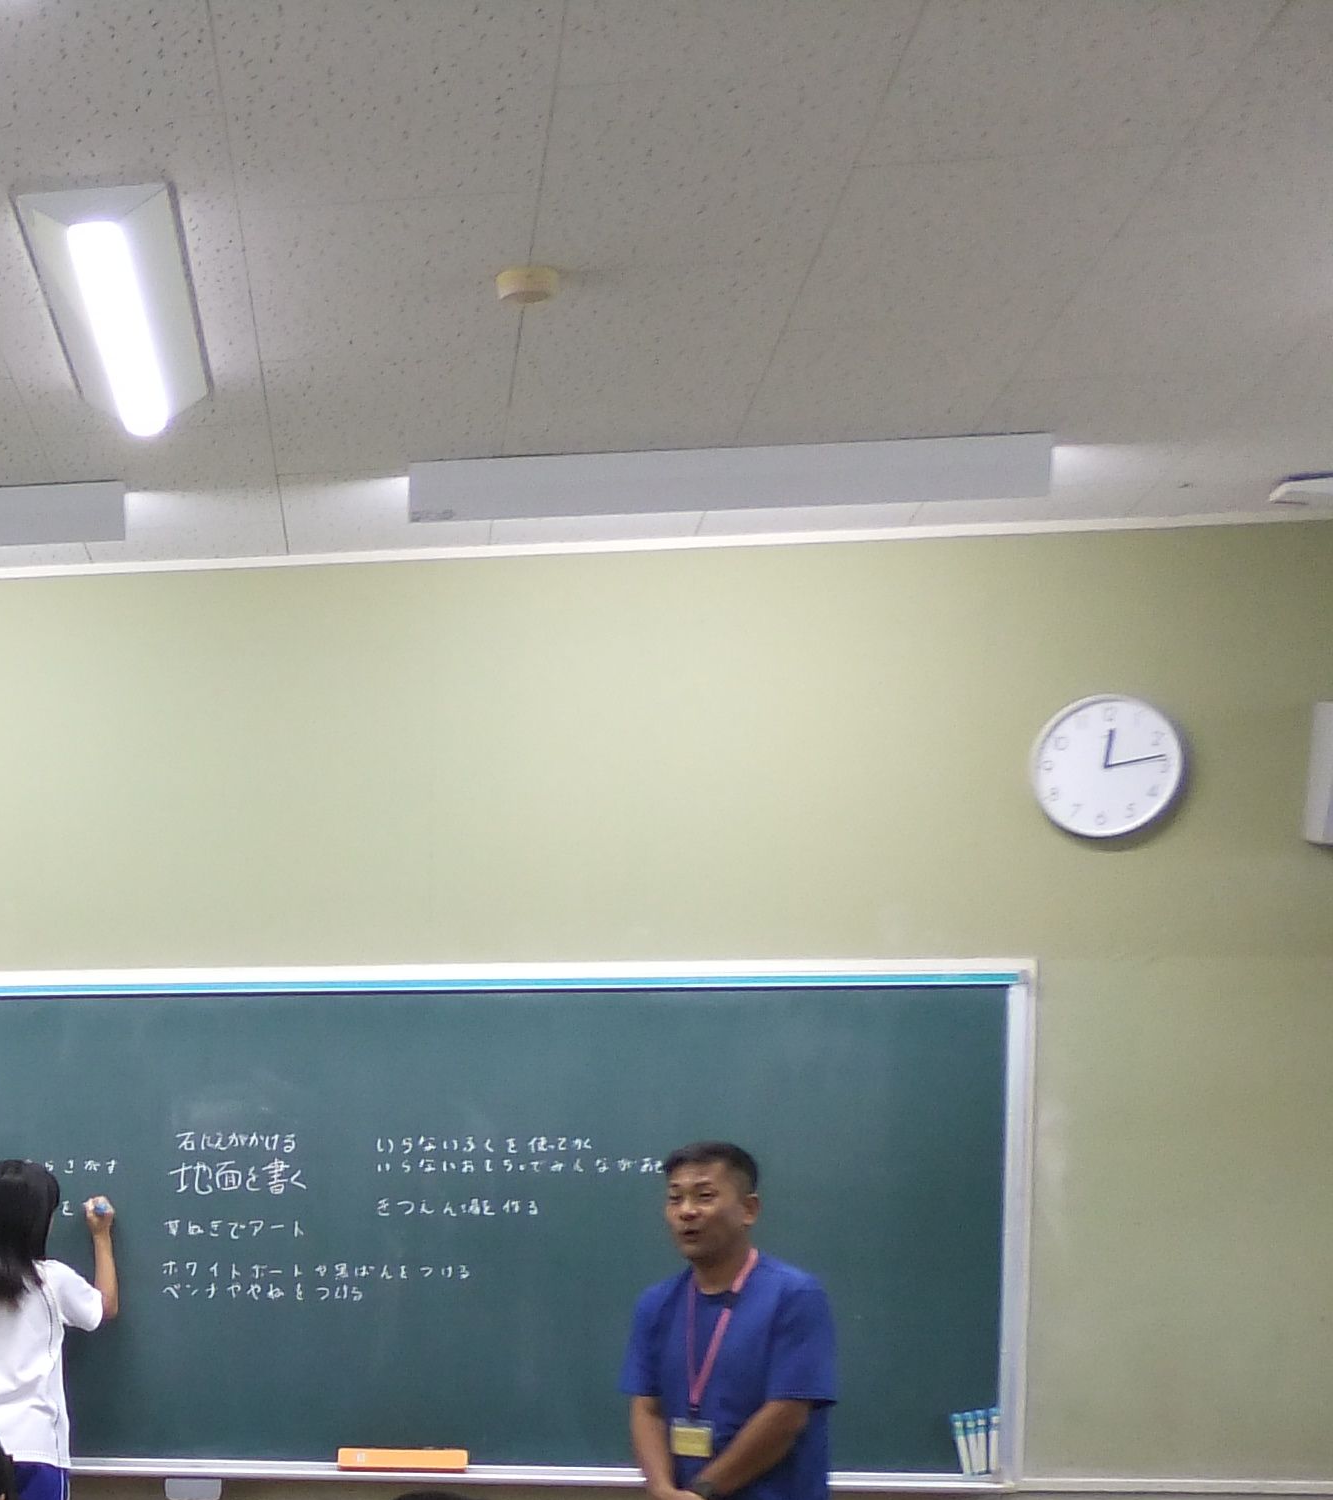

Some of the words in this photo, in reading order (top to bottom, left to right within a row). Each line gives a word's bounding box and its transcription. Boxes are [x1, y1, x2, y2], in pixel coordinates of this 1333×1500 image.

[168, 1157, 307, 1195] 地面を書く
